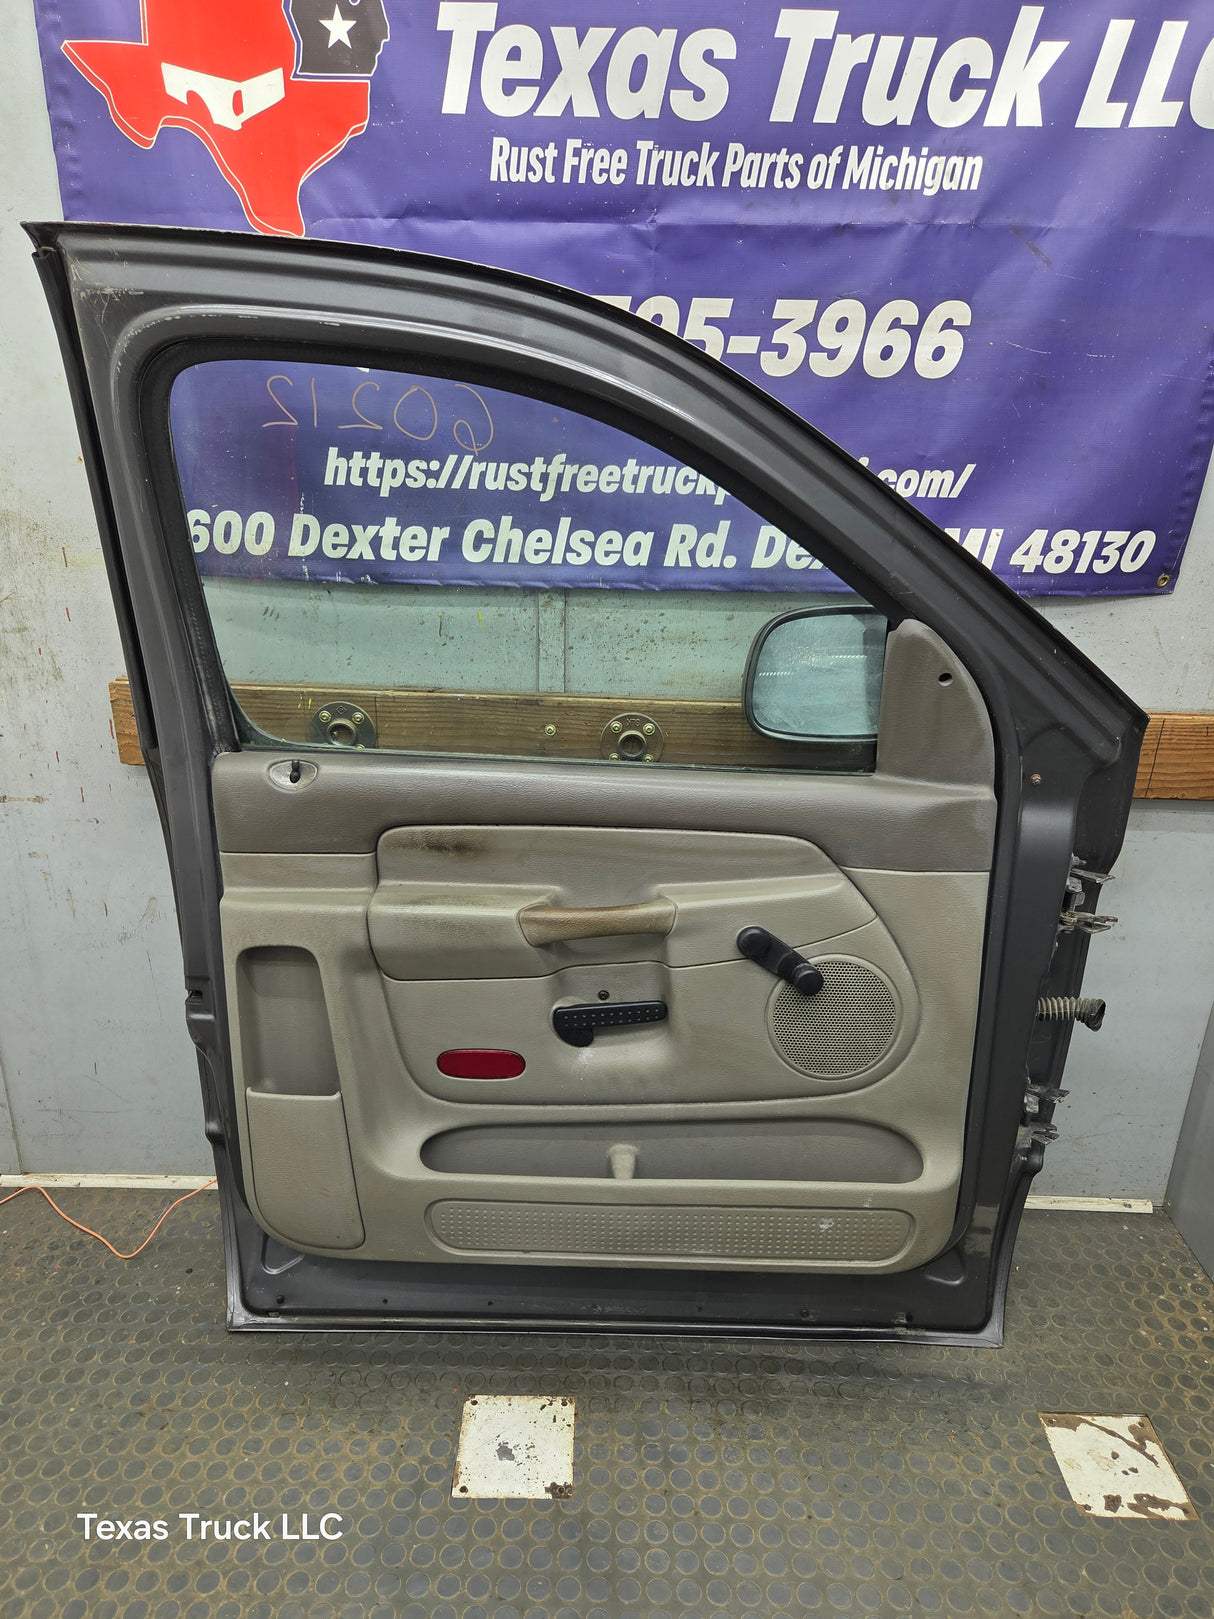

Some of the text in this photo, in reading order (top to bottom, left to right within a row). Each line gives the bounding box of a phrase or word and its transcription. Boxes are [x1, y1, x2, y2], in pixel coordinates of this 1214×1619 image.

[437, 1, 736, 121] Texas
[769, 6, 1071, 128] Truck
[490, 137, 983, 196] Rust Free Truck Parts of Michigan
[288, 514, 450, 561] Dexter
[462, 516, 654, 566] Chelsea
[663, 520, 737, 568] Rd.
[751, 525, 824, 570] De
[1009, 529, 1156, 574] 48130
